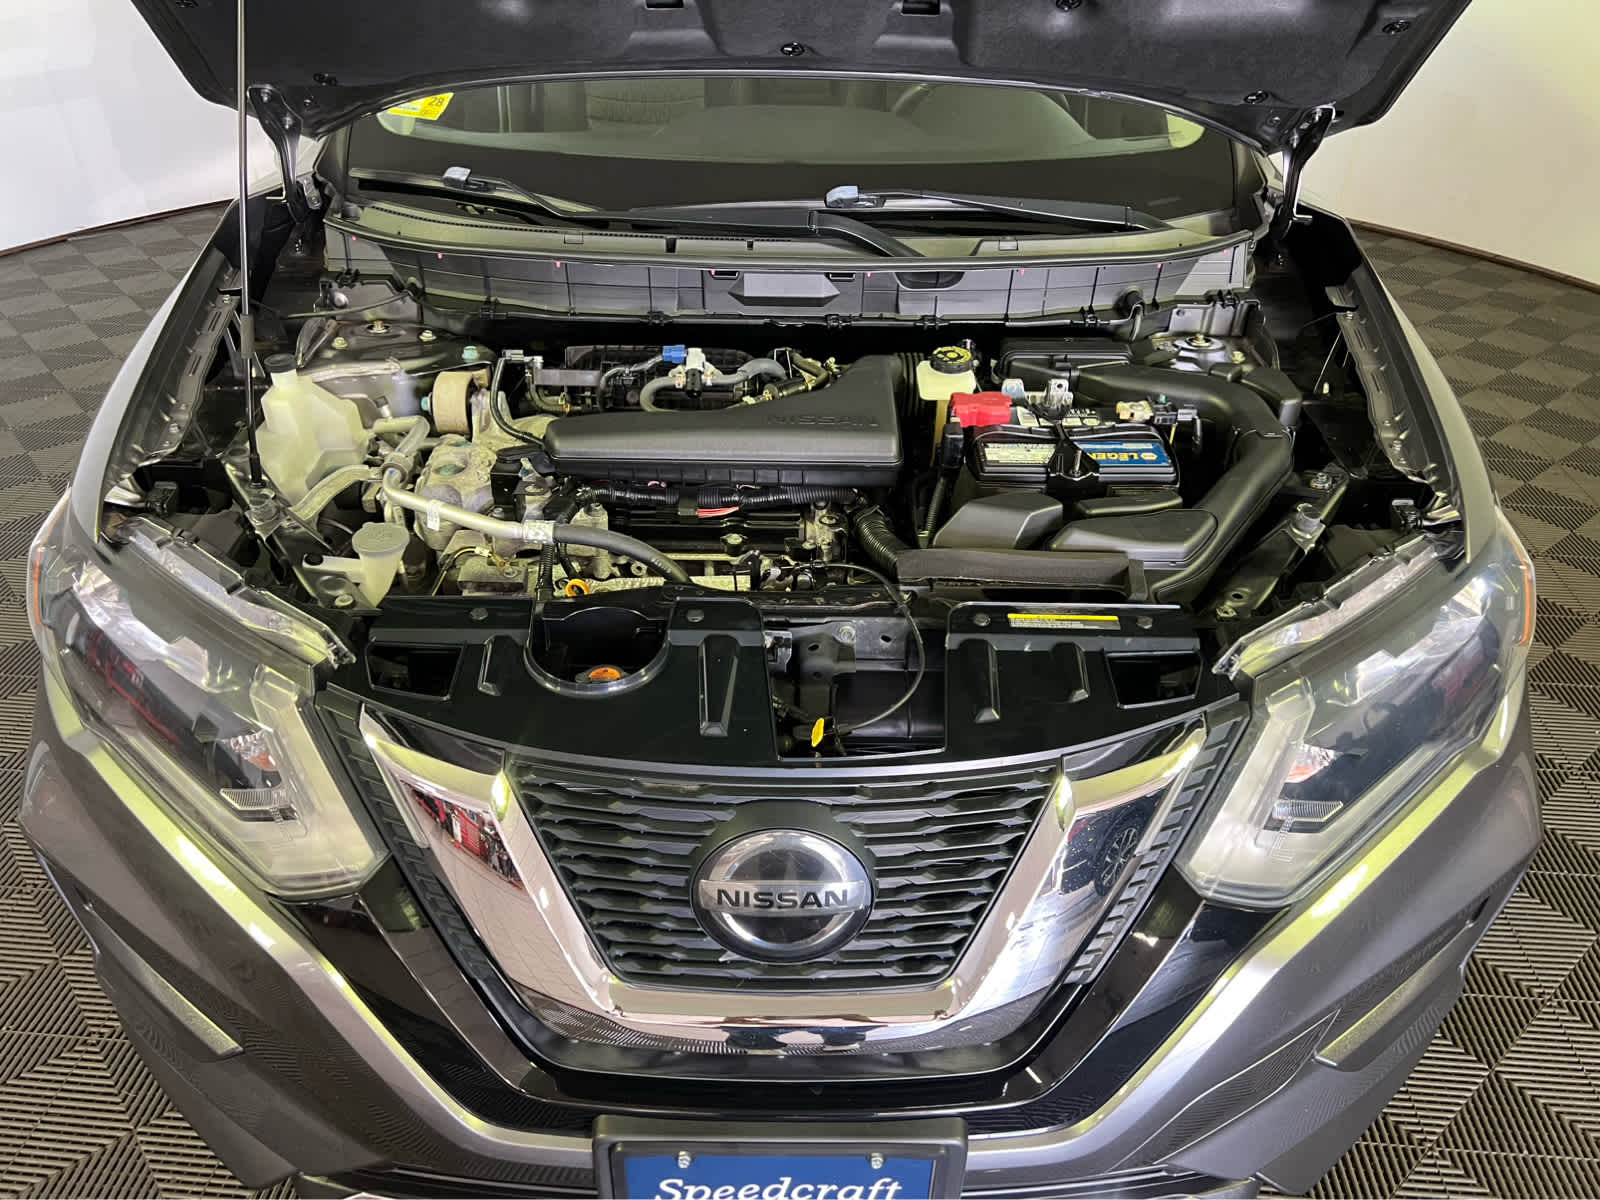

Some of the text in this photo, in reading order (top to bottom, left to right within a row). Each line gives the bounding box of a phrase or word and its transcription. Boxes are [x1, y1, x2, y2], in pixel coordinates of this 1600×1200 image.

[428, 96, 445, 107] 28
[767, 414, 879, 427] NISSAN
[1086, 452, 1140, 461] LEGEN
[716, 888, 848, 909] NISSAN
[653, 1177, 903, 1200] Speedcraft
